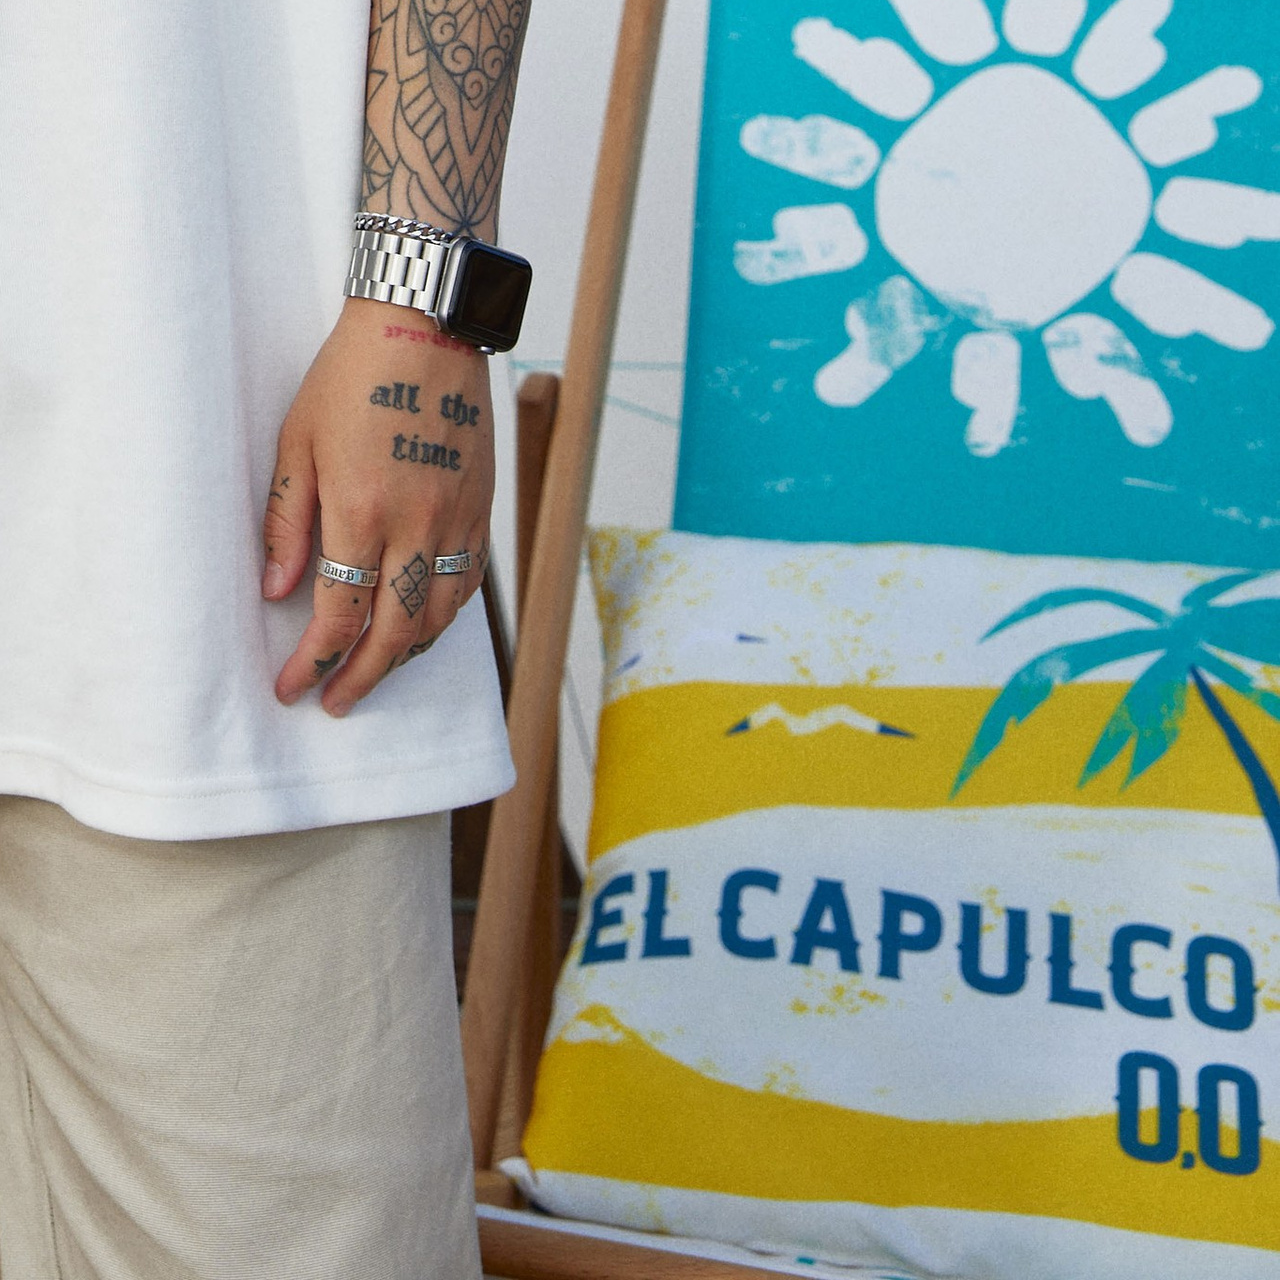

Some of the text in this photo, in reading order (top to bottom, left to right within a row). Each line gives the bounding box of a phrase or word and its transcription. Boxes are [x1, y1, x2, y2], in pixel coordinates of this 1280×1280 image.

[370, 382, 480, 427] all the
[392, 434, 461, 471] time
[580, 869, 1258, 1031] EL CAPULCO
